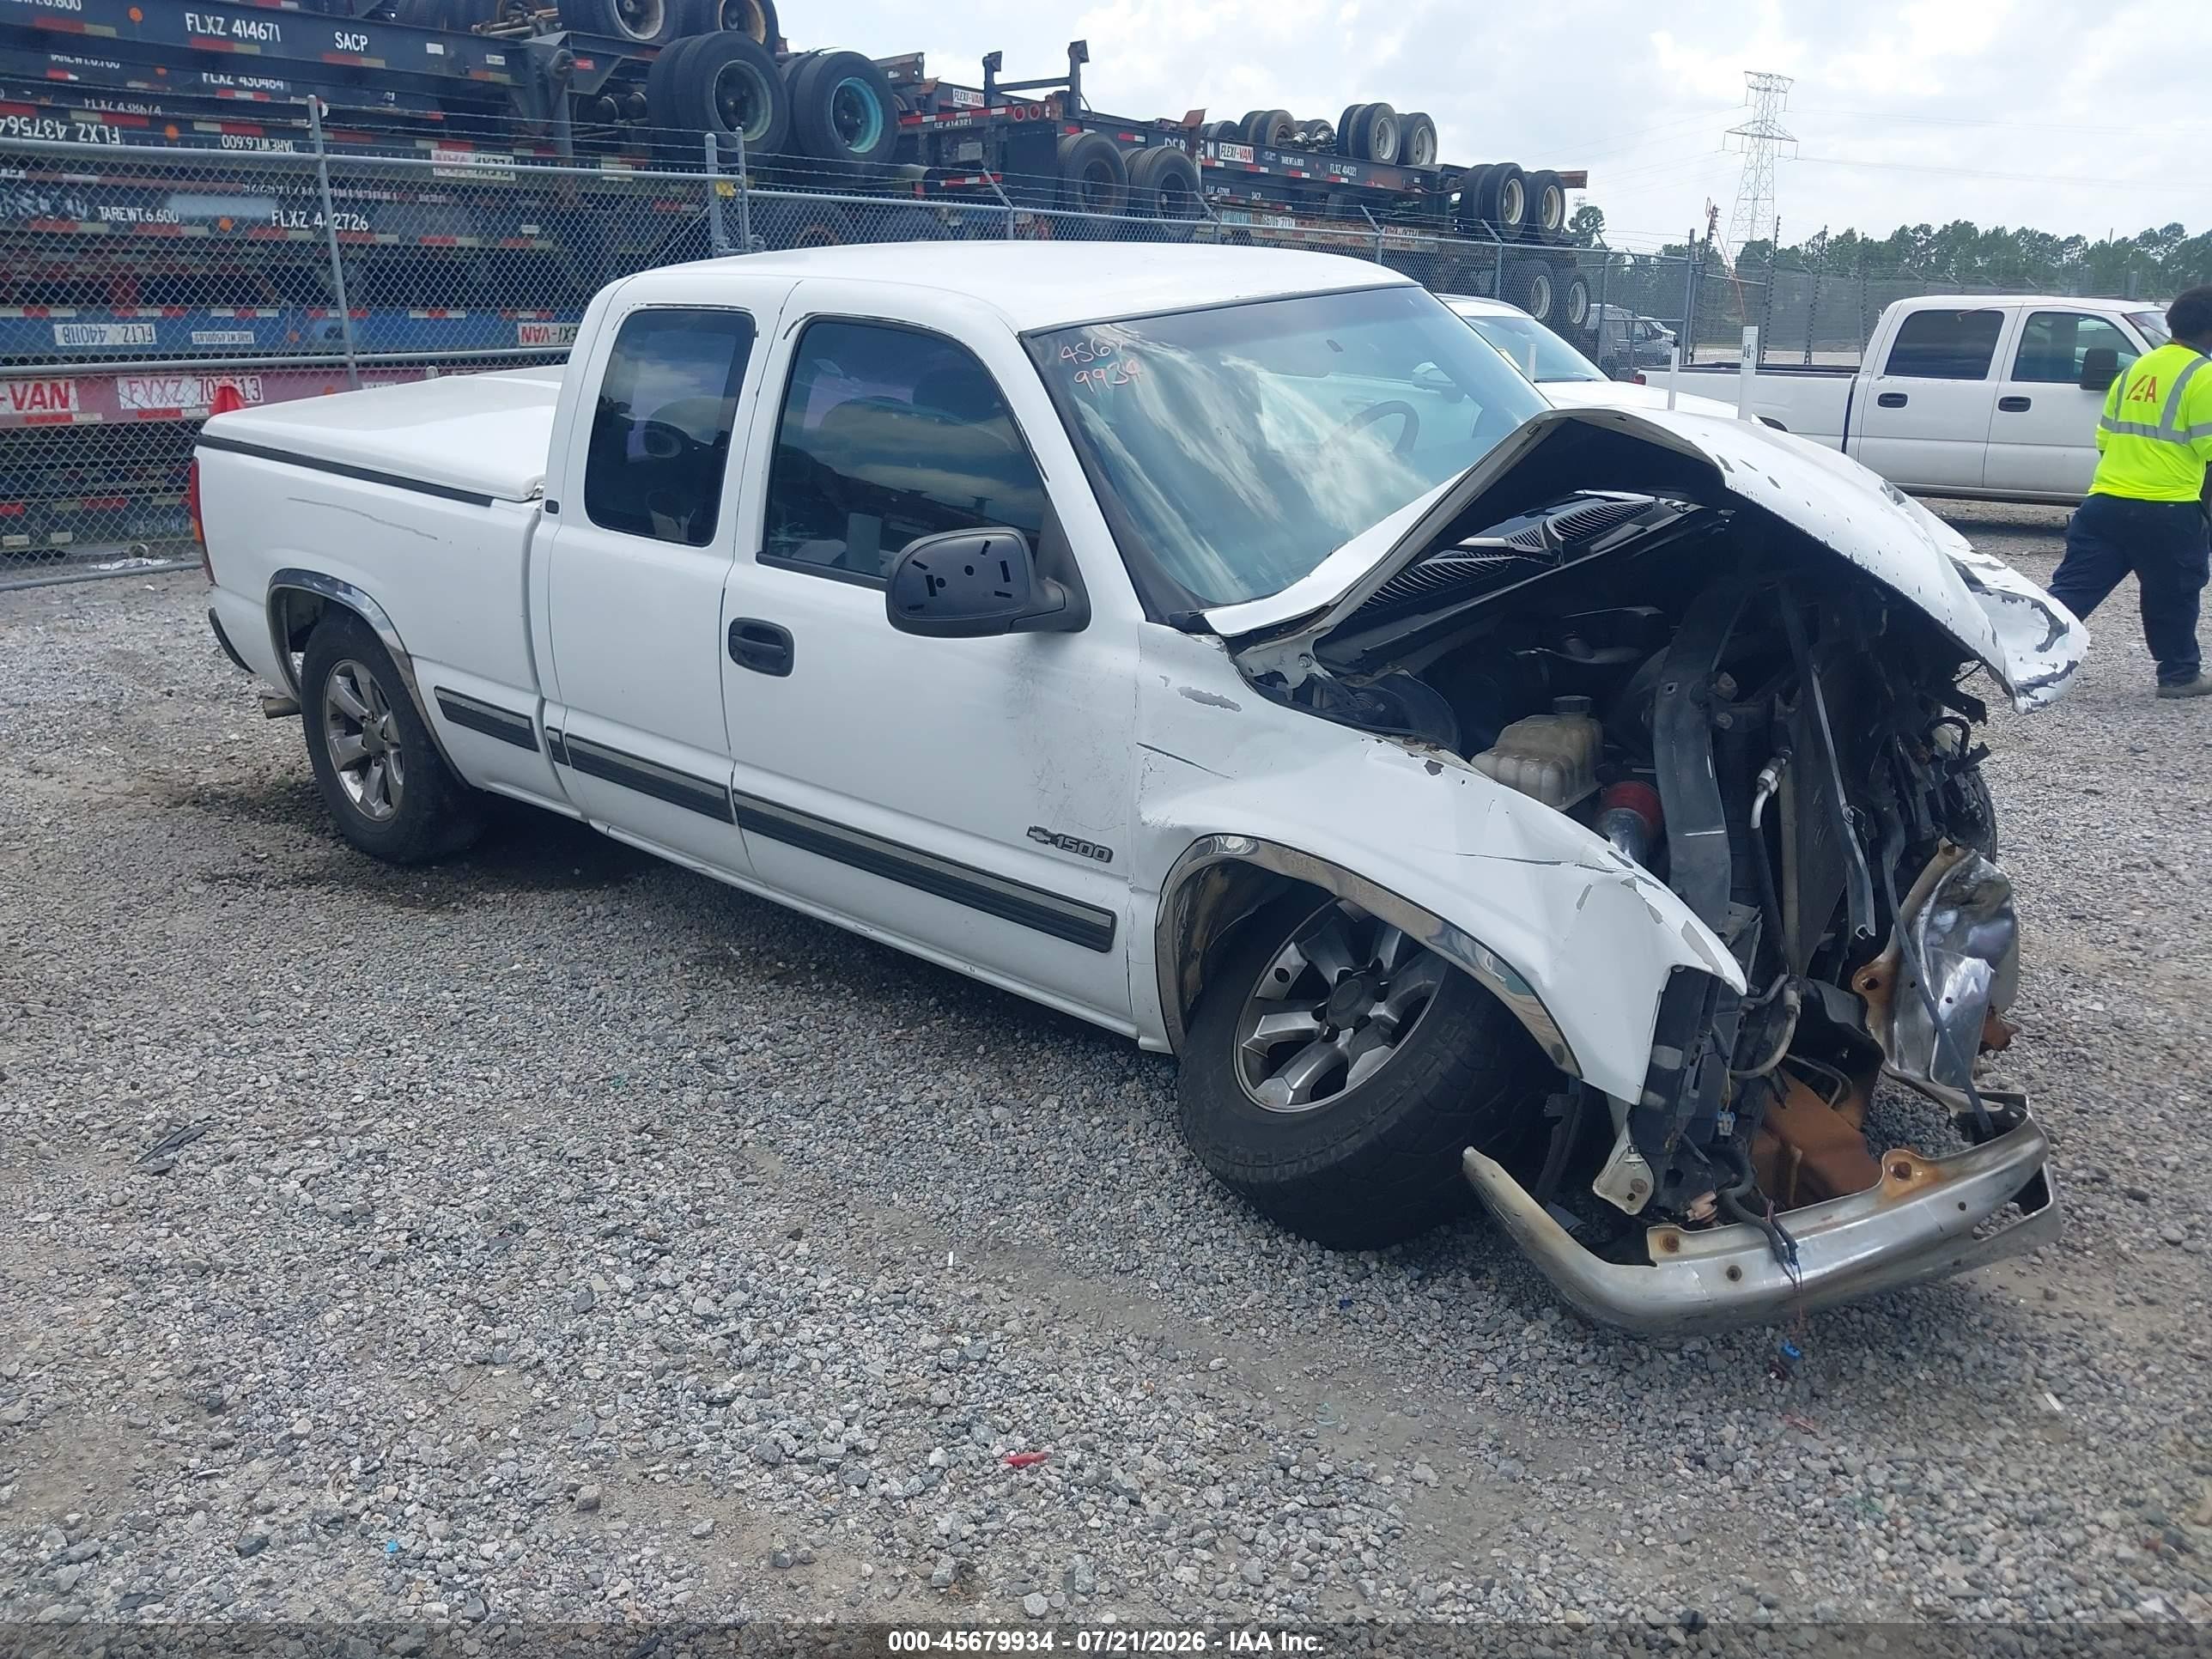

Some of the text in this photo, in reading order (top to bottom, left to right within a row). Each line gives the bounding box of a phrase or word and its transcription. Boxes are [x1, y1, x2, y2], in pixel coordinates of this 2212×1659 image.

[185, 12, 282, 42] FLXZ 414671
[334, 31, 368, 52] SACP
[954, 90, 984, 106] FLEXI-VAN
[76, 122, 121, 145] FLXZ
[1221, 144, 1253, 161] FLEXI-VAN
[271, 209, 369, 232] FLXZ 42726
[63, 325, 155, 343] FLTZ 440118
[195, 377, 261, 403] 7013
[1056, 836, 1111, 862] 1500
